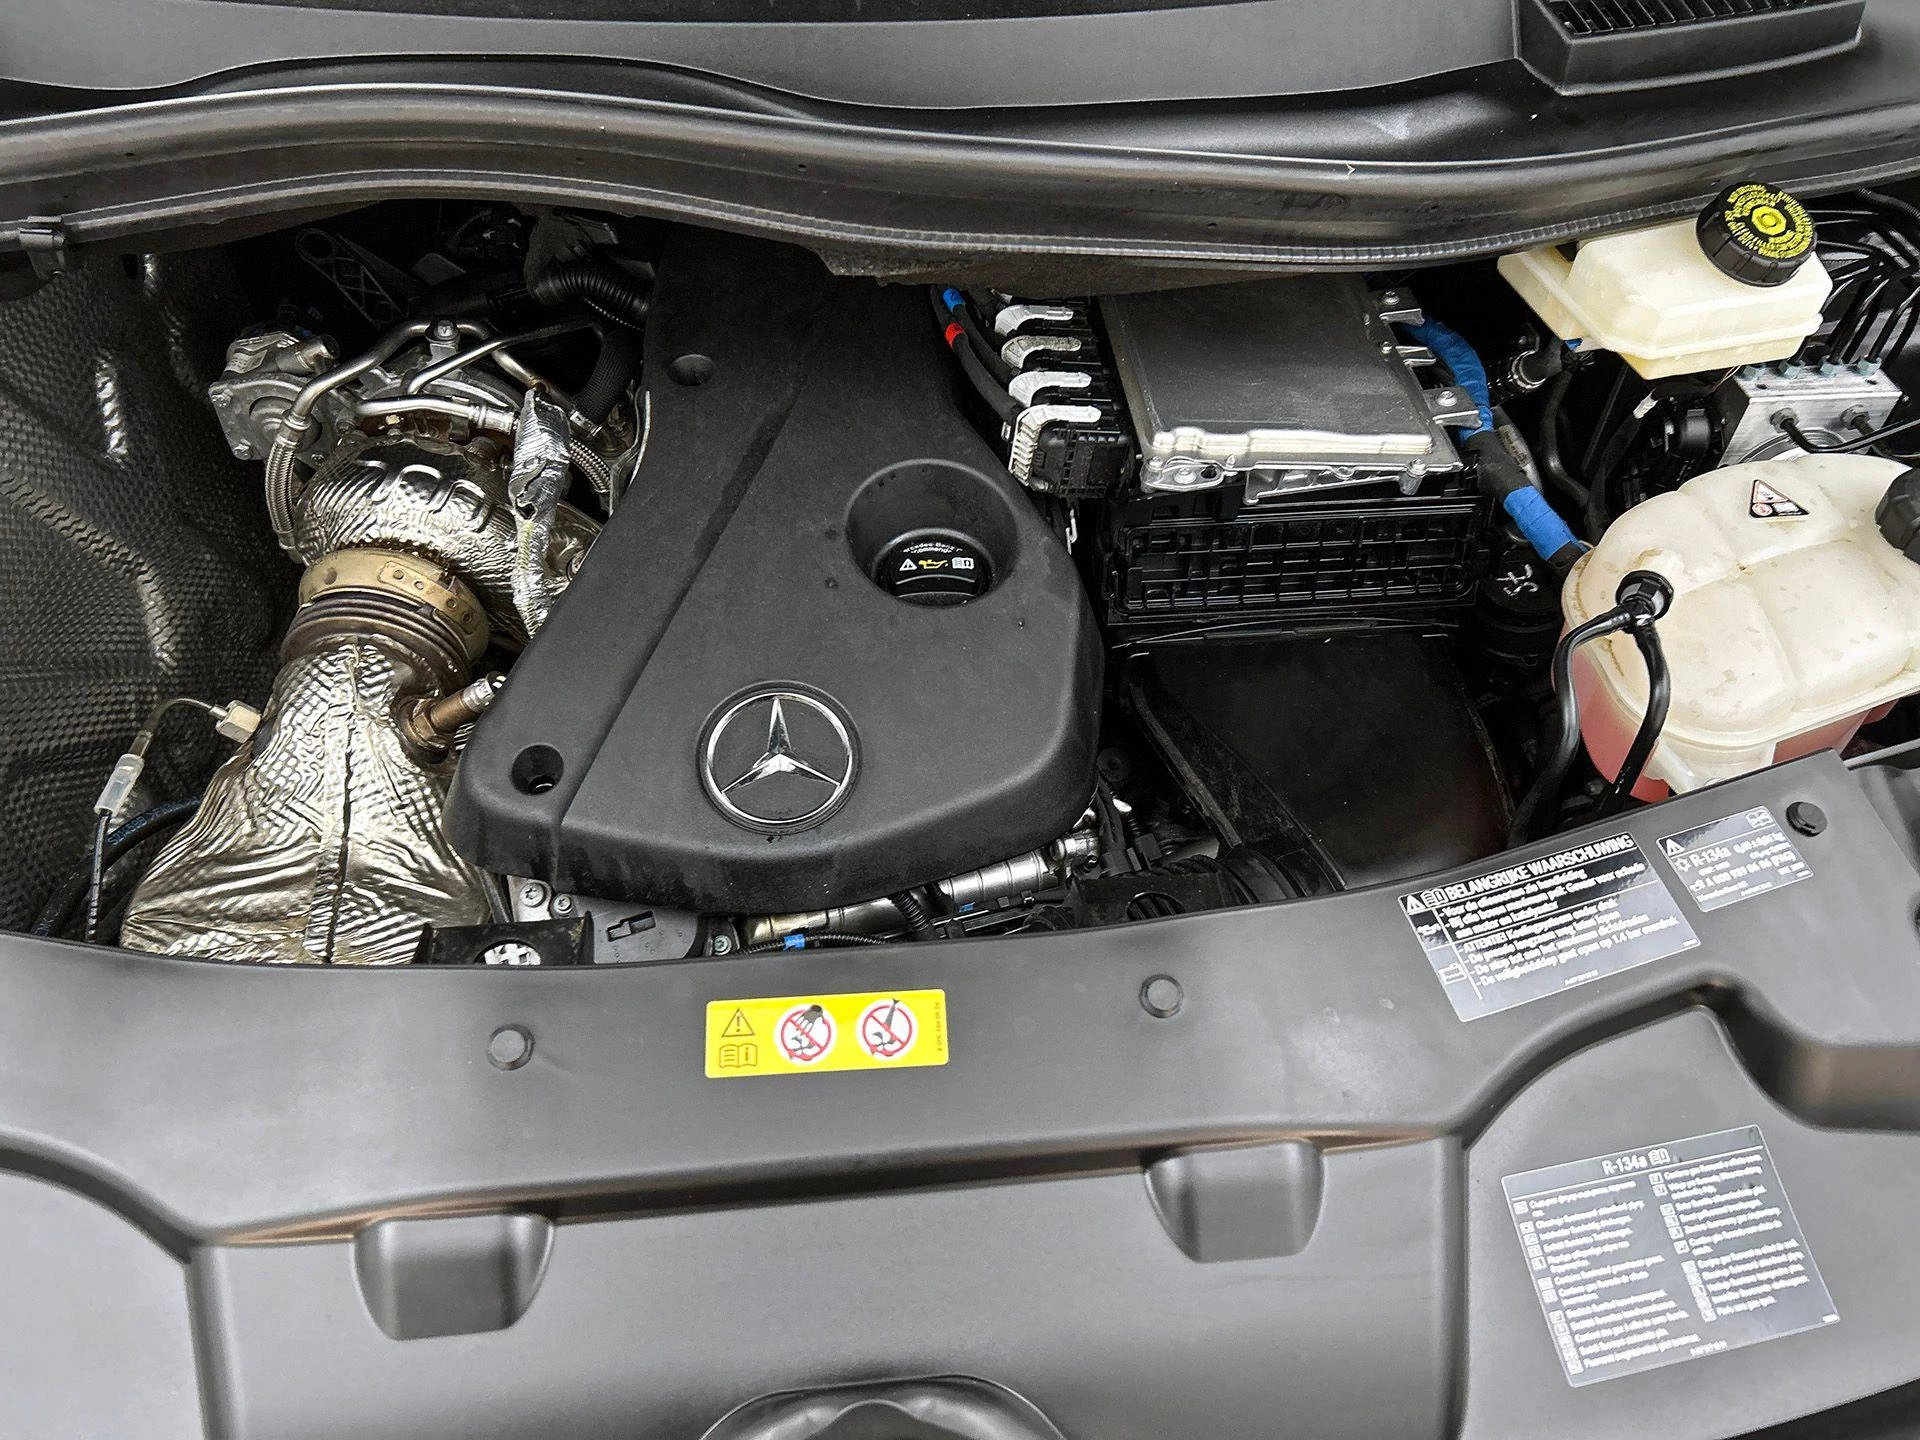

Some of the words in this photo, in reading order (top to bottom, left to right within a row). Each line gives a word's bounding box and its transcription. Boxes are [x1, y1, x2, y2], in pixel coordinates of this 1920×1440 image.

[1689, 847, 1732, 867] R-134a
[1447, 866, 1531, 900] BELANGRIJKE
[1529, 835, 1633, 875] WAARSCHUWING
[1602, 1155, 1647, 1175] R-134a
